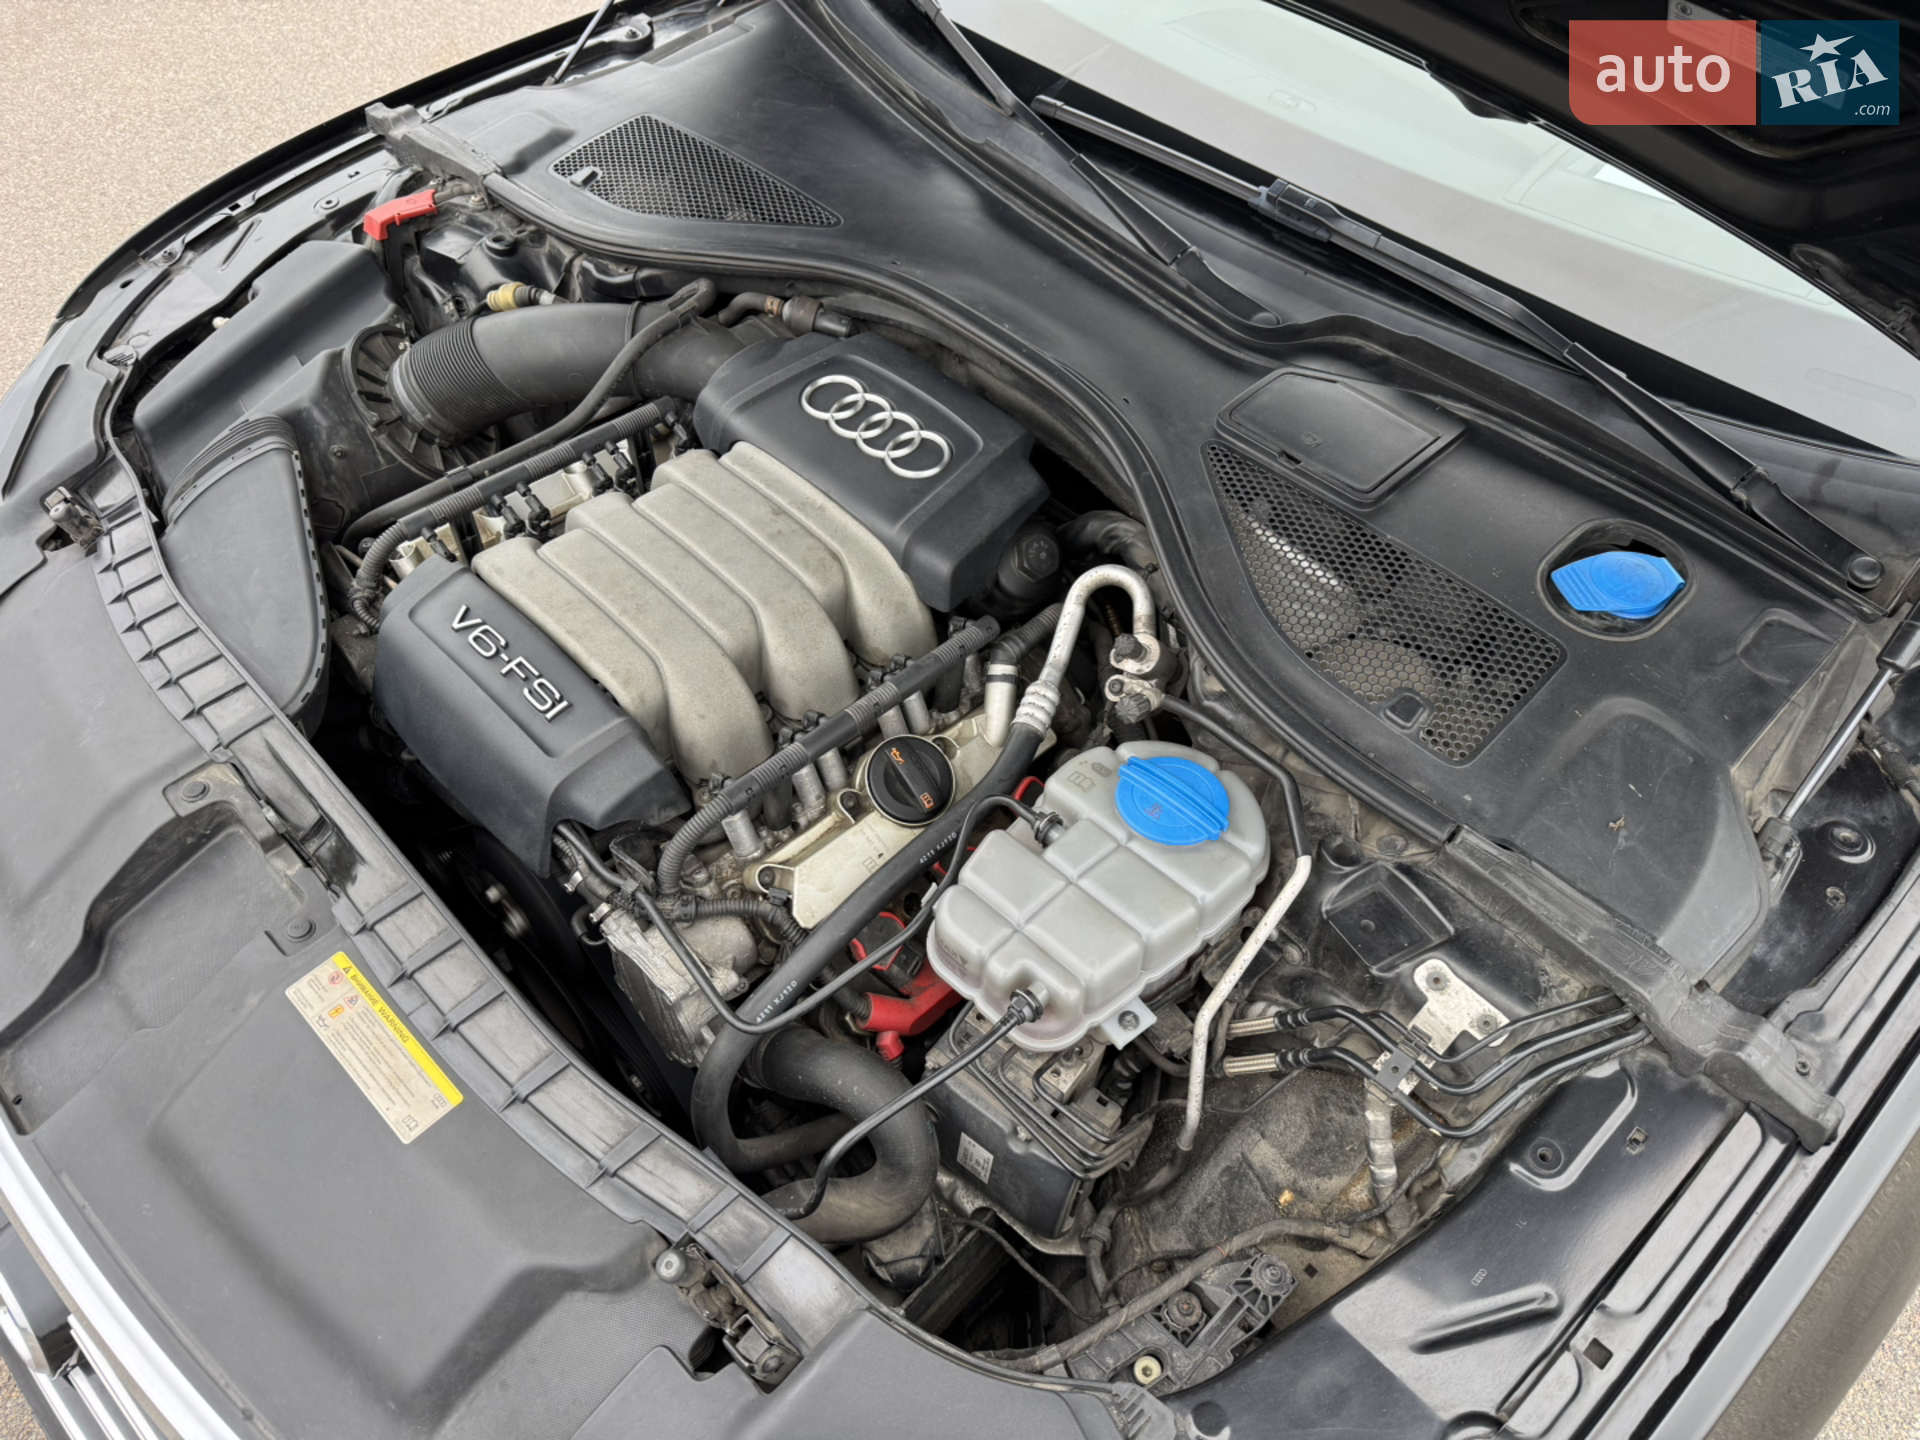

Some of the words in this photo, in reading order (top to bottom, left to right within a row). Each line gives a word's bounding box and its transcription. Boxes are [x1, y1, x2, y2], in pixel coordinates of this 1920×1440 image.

[451, 604, 571, 722] V6-FSI
[351, 974, 380, 1006] ВНИМАНИЕ
[378, 1006, 410, 1044] WARNING
